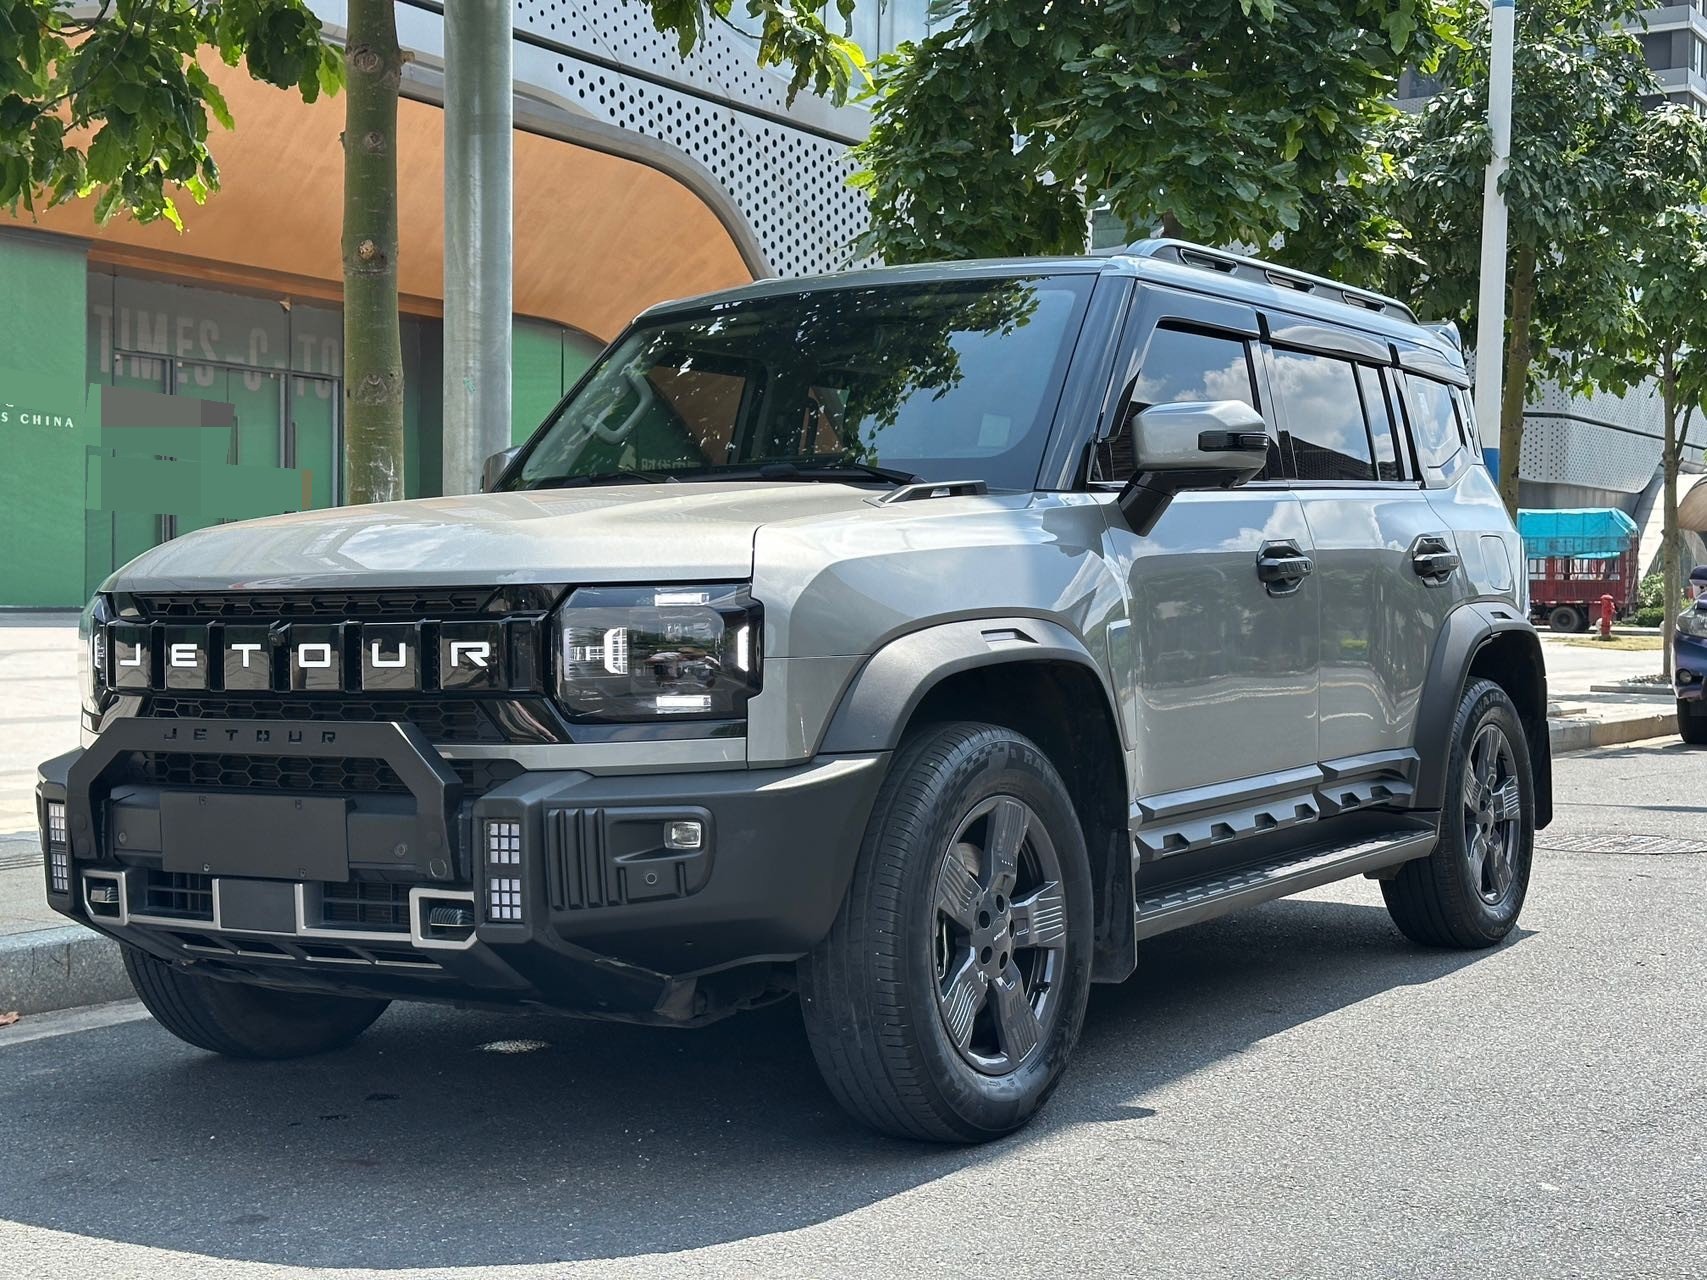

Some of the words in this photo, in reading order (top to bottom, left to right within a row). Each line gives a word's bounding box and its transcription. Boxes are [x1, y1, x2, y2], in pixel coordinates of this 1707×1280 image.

[20, 414, 73, 428] CHINA
[119, 642, 490, 667] JETOUR
[163, 728, 336, 744] JETOUR
